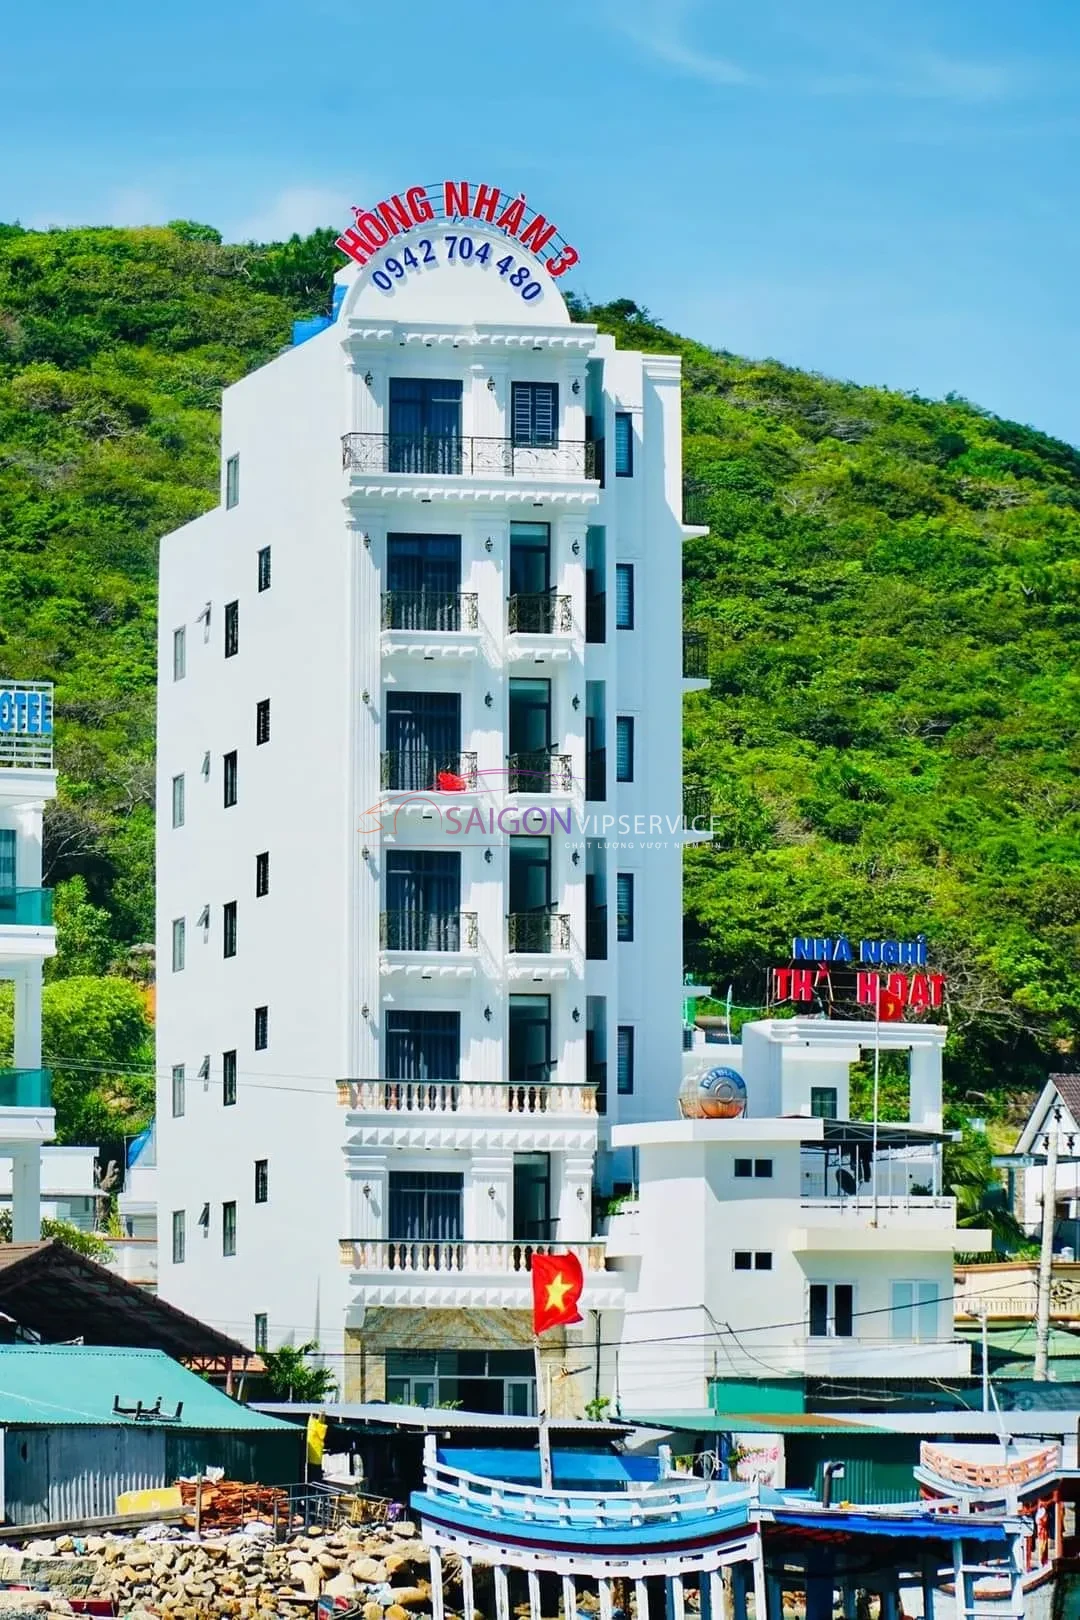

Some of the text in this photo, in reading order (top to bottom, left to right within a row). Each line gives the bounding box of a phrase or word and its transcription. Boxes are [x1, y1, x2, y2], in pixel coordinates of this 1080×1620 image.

[335, 180, 580, 278] HỒNG NHÀN 3
[371, 236, 542, 301] 0942 704 480
[792, 935, 853, 961] NHÀ
